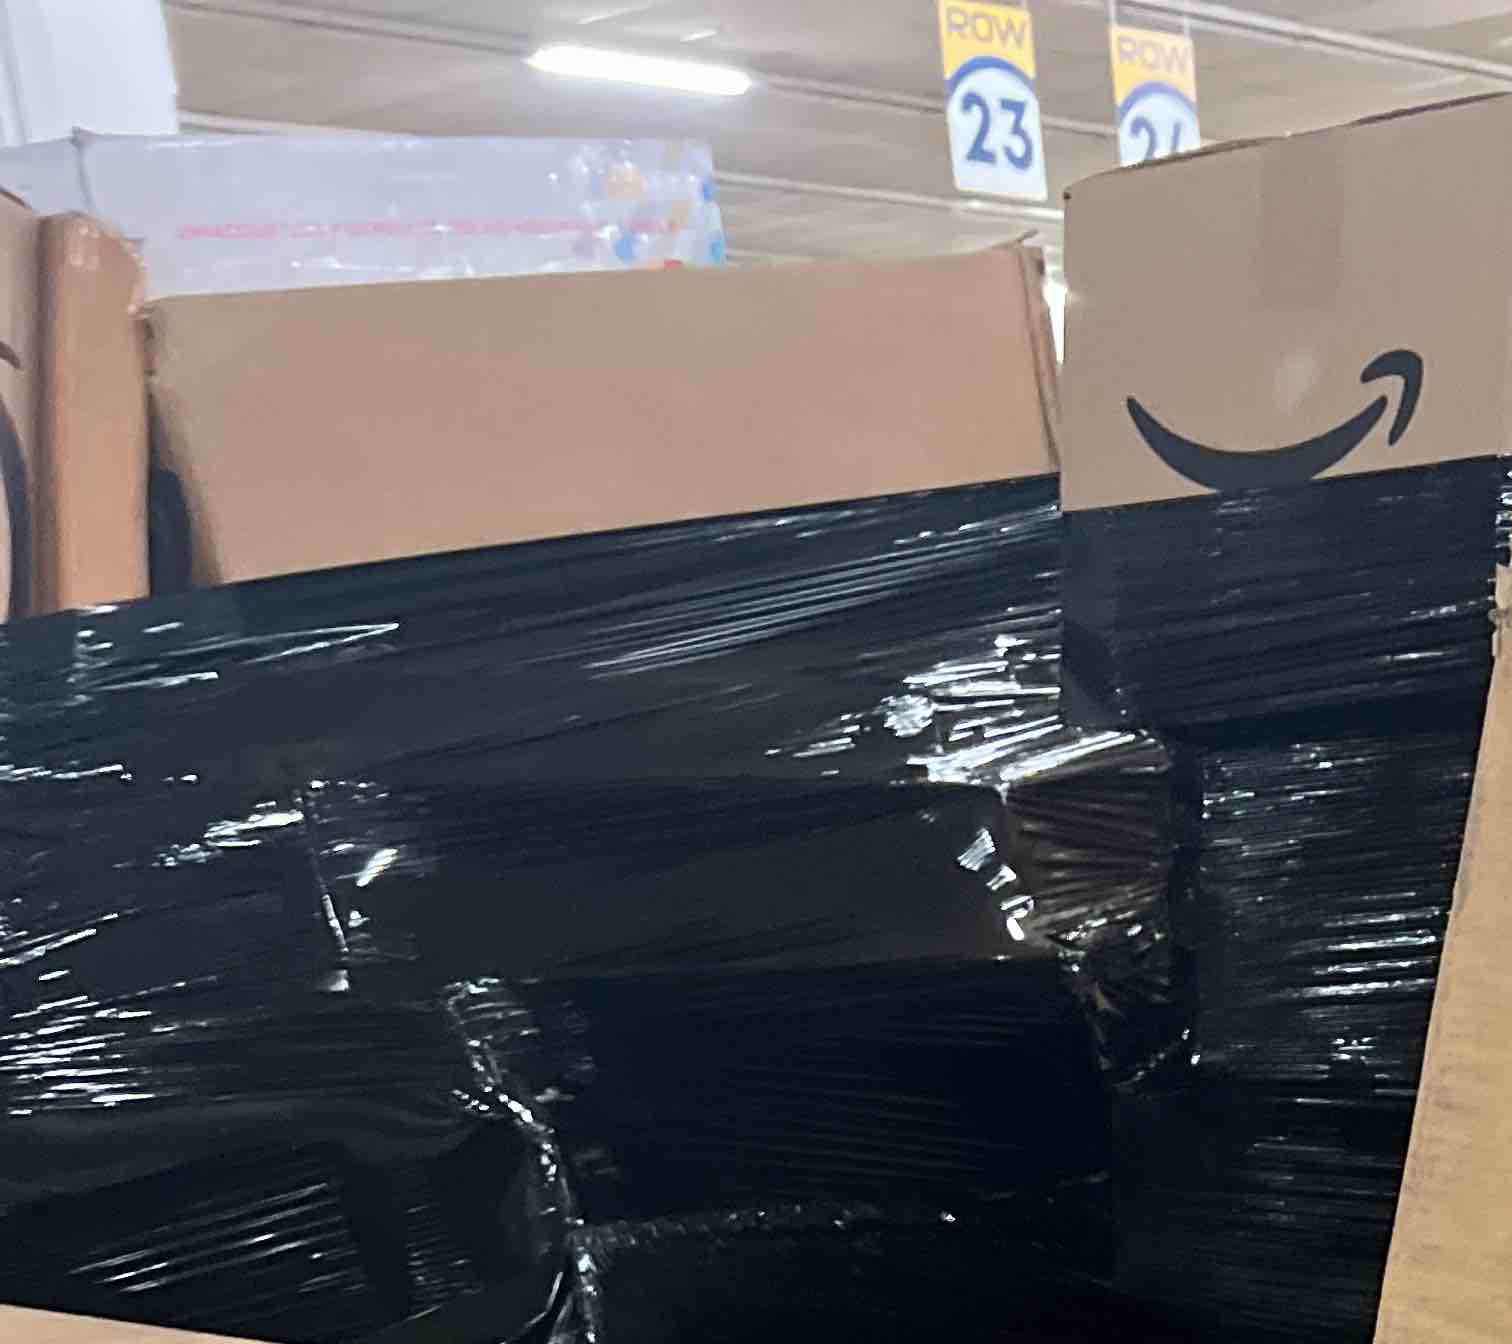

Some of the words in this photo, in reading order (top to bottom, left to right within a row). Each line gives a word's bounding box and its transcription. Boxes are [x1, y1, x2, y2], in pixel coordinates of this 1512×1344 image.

[947, 7, 1026, 48] ROW
[1117, 34, 1191, 73] ROW
[961, 91, 1034, 173] 23
